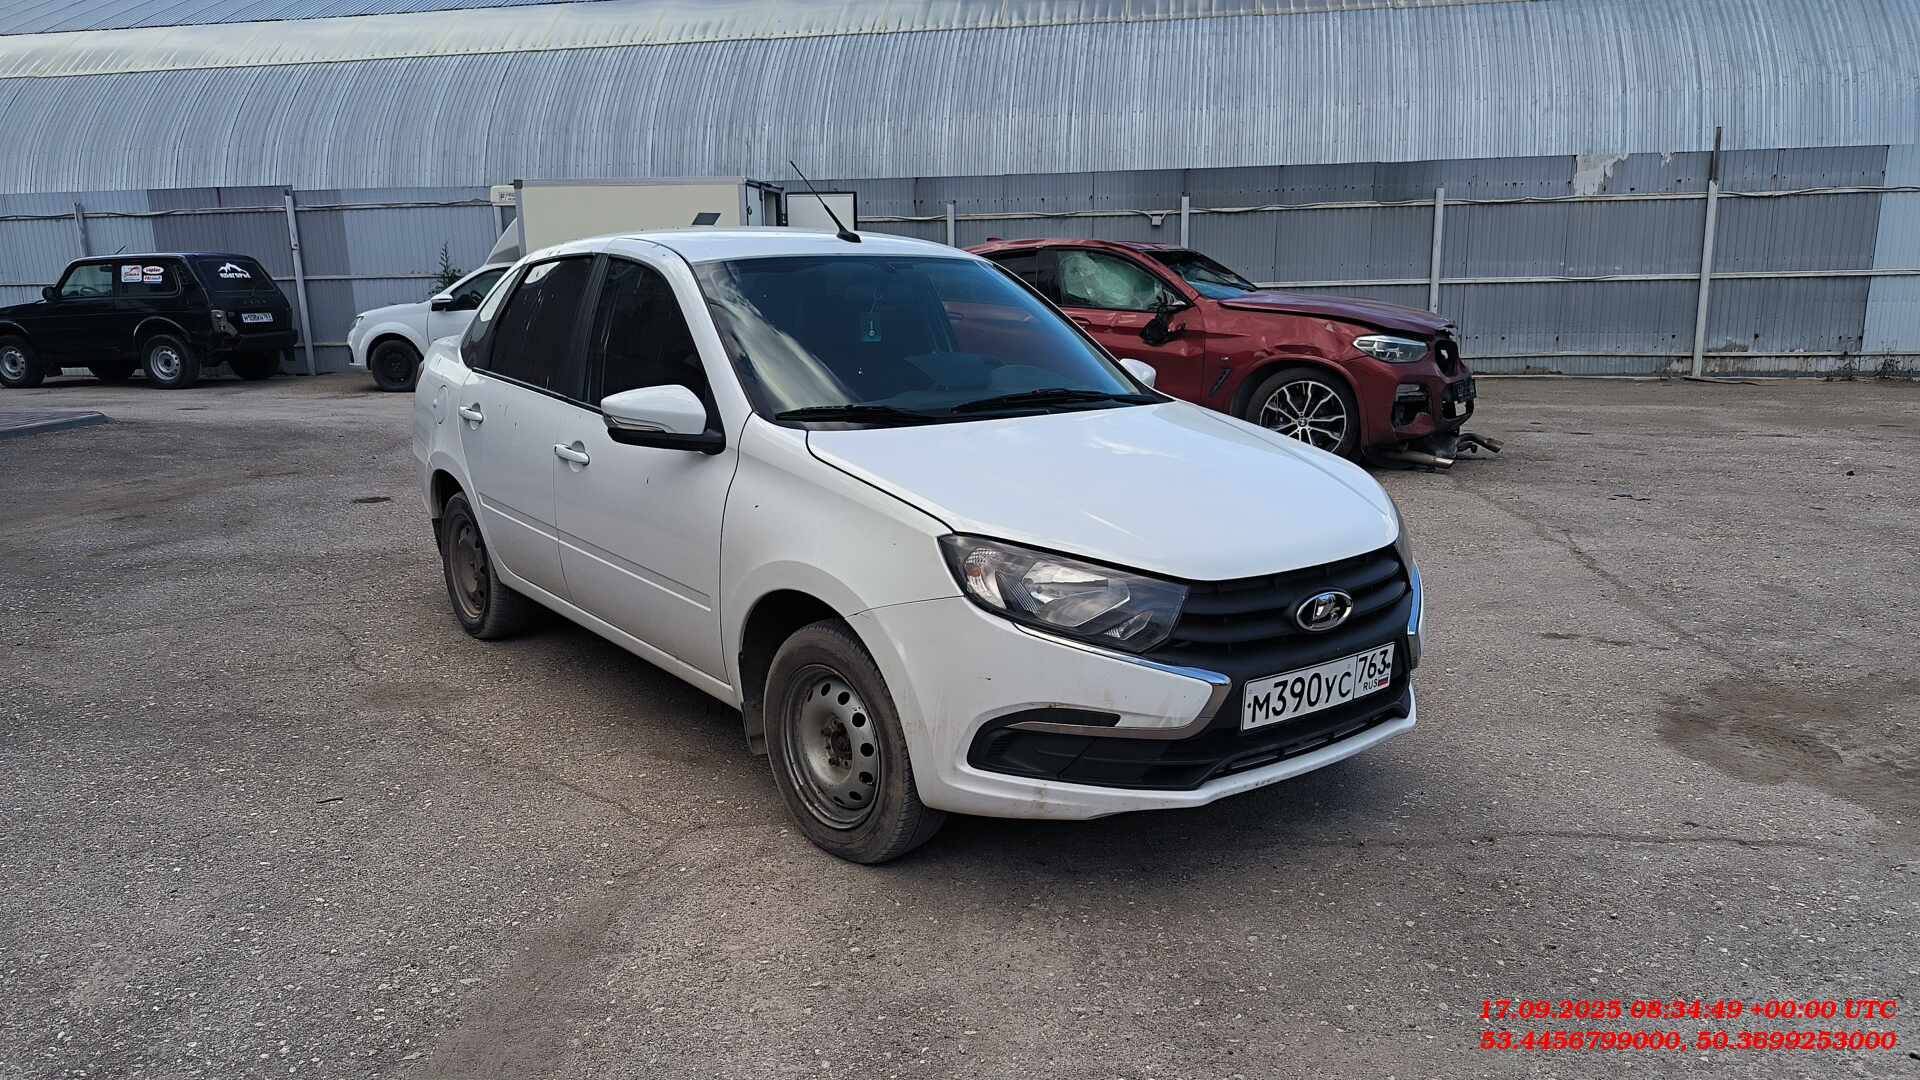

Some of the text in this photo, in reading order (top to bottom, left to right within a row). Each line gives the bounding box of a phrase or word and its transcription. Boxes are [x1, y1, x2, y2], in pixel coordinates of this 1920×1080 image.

[1251, 649, 1389, 722] М390УС 763
[1362, 678, 1378, 692] RUS
